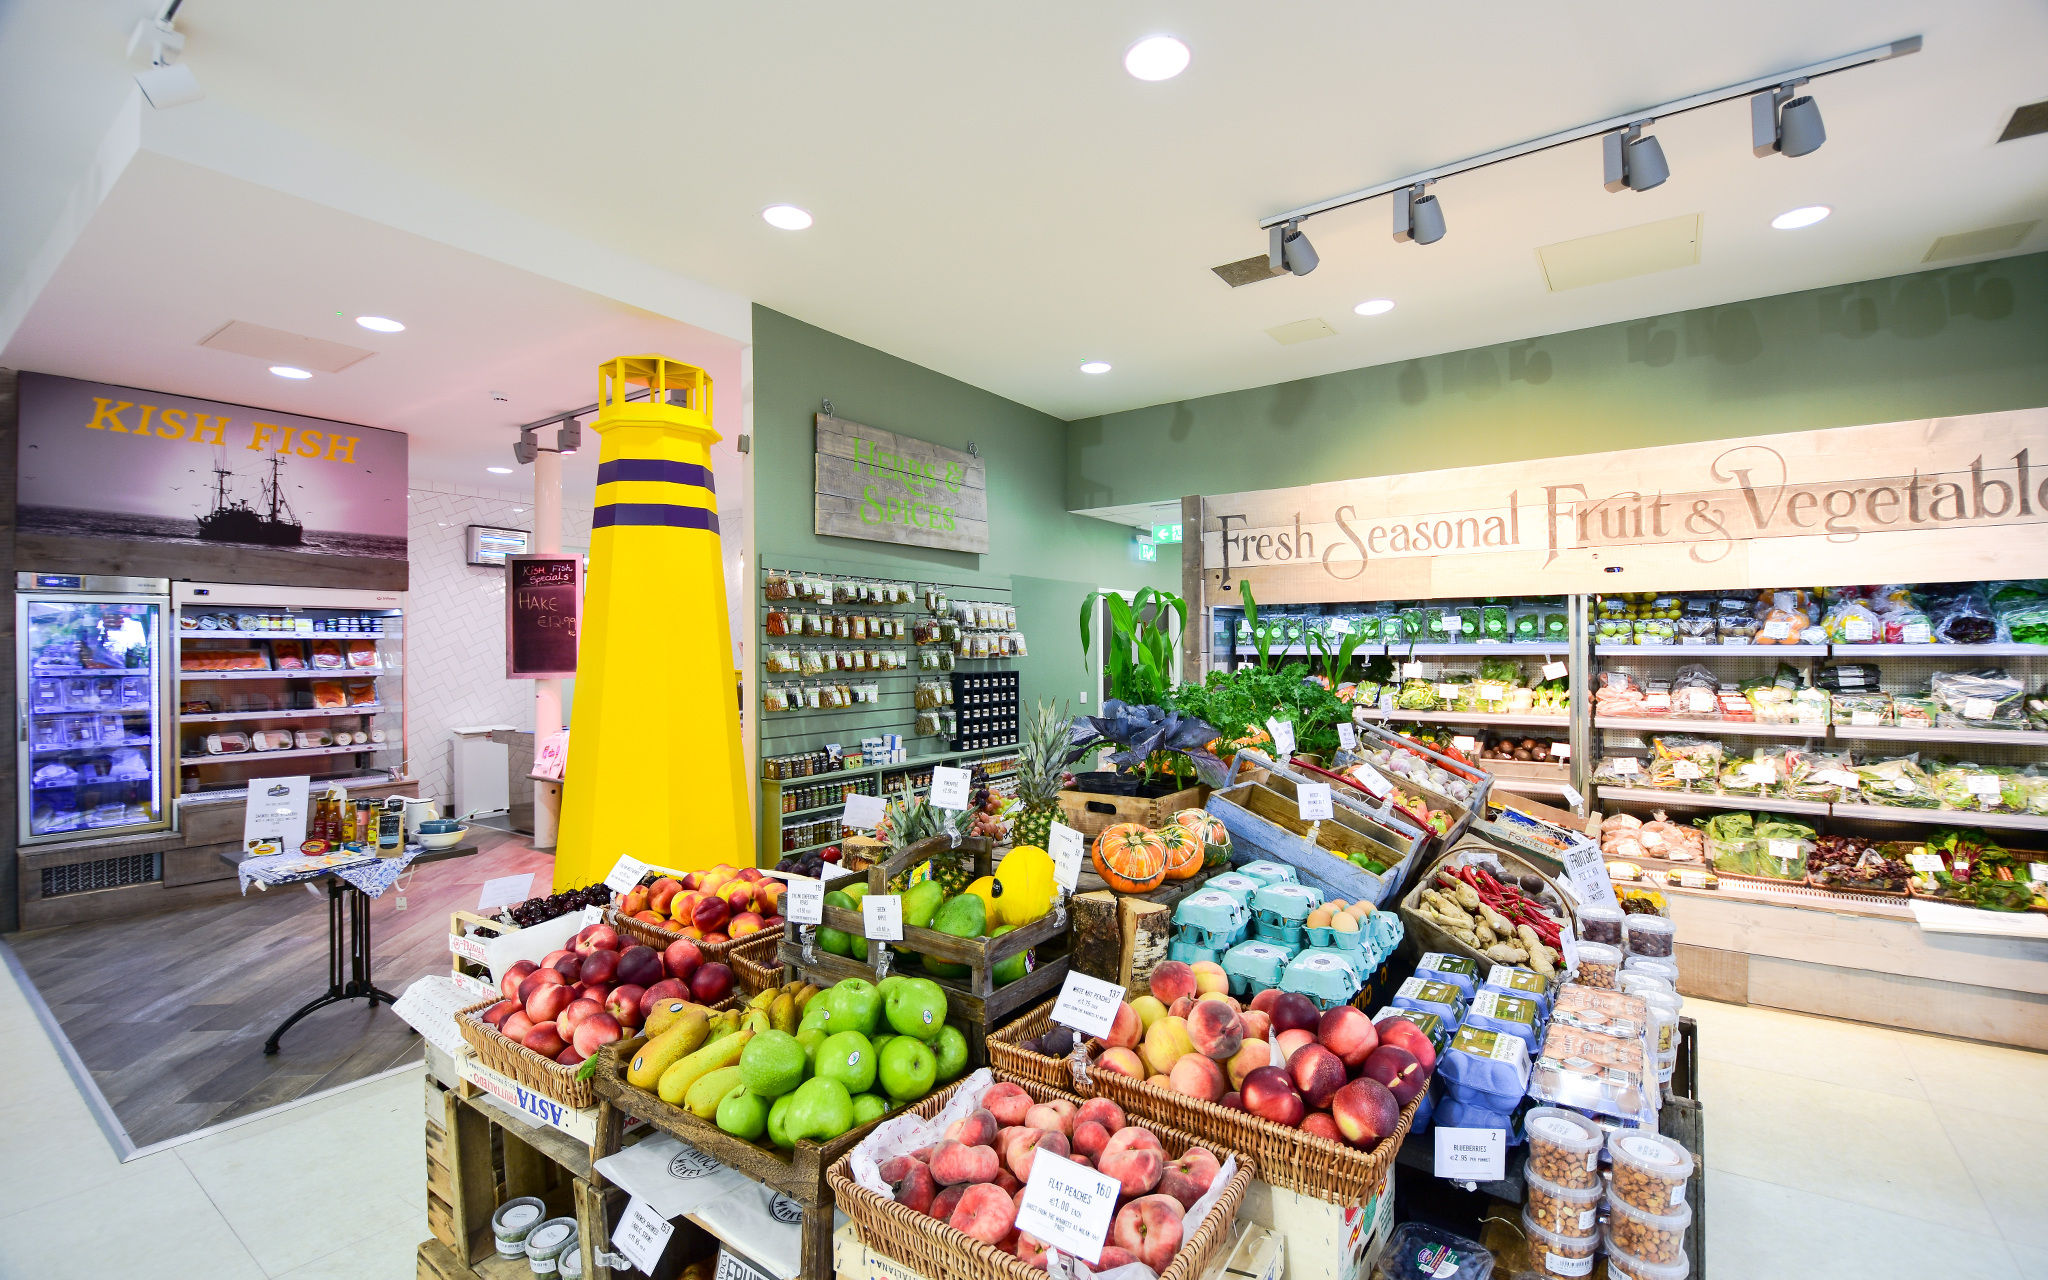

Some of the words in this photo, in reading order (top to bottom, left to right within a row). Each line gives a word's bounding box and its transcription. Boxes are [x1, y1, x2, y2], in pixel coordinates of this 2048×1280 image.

[85, 396, 233, 447] KISH
[245, 420, 362, 465] FISH
[944, 460, 965, 494] &
[1216, 512, 1316, 591] Fresh
[1321, 489, 1520, 581] Seasonal
[1541, 482, 1672, 570] Fruit
[1688, 497, 1734, 566] &
[1110, 988, 1120, 998] 137
[516, 1086, 564, 1127] ASTA
[1492, 1132, 1496, 1140] 2
[1454, 1144, 1486, 1152] BLUEBERRIES
[1048, 1178, 1064, 1192] FLAT
[1064, 1184, 1092, 1206] PEACHES
[1096, 1182, 1112, 1198] 160
[775, 1200, 803, 1221] MARKE
[1050, 1198, 1070, 1212] €1.00
[660, 1222, 670, 1234] 153
